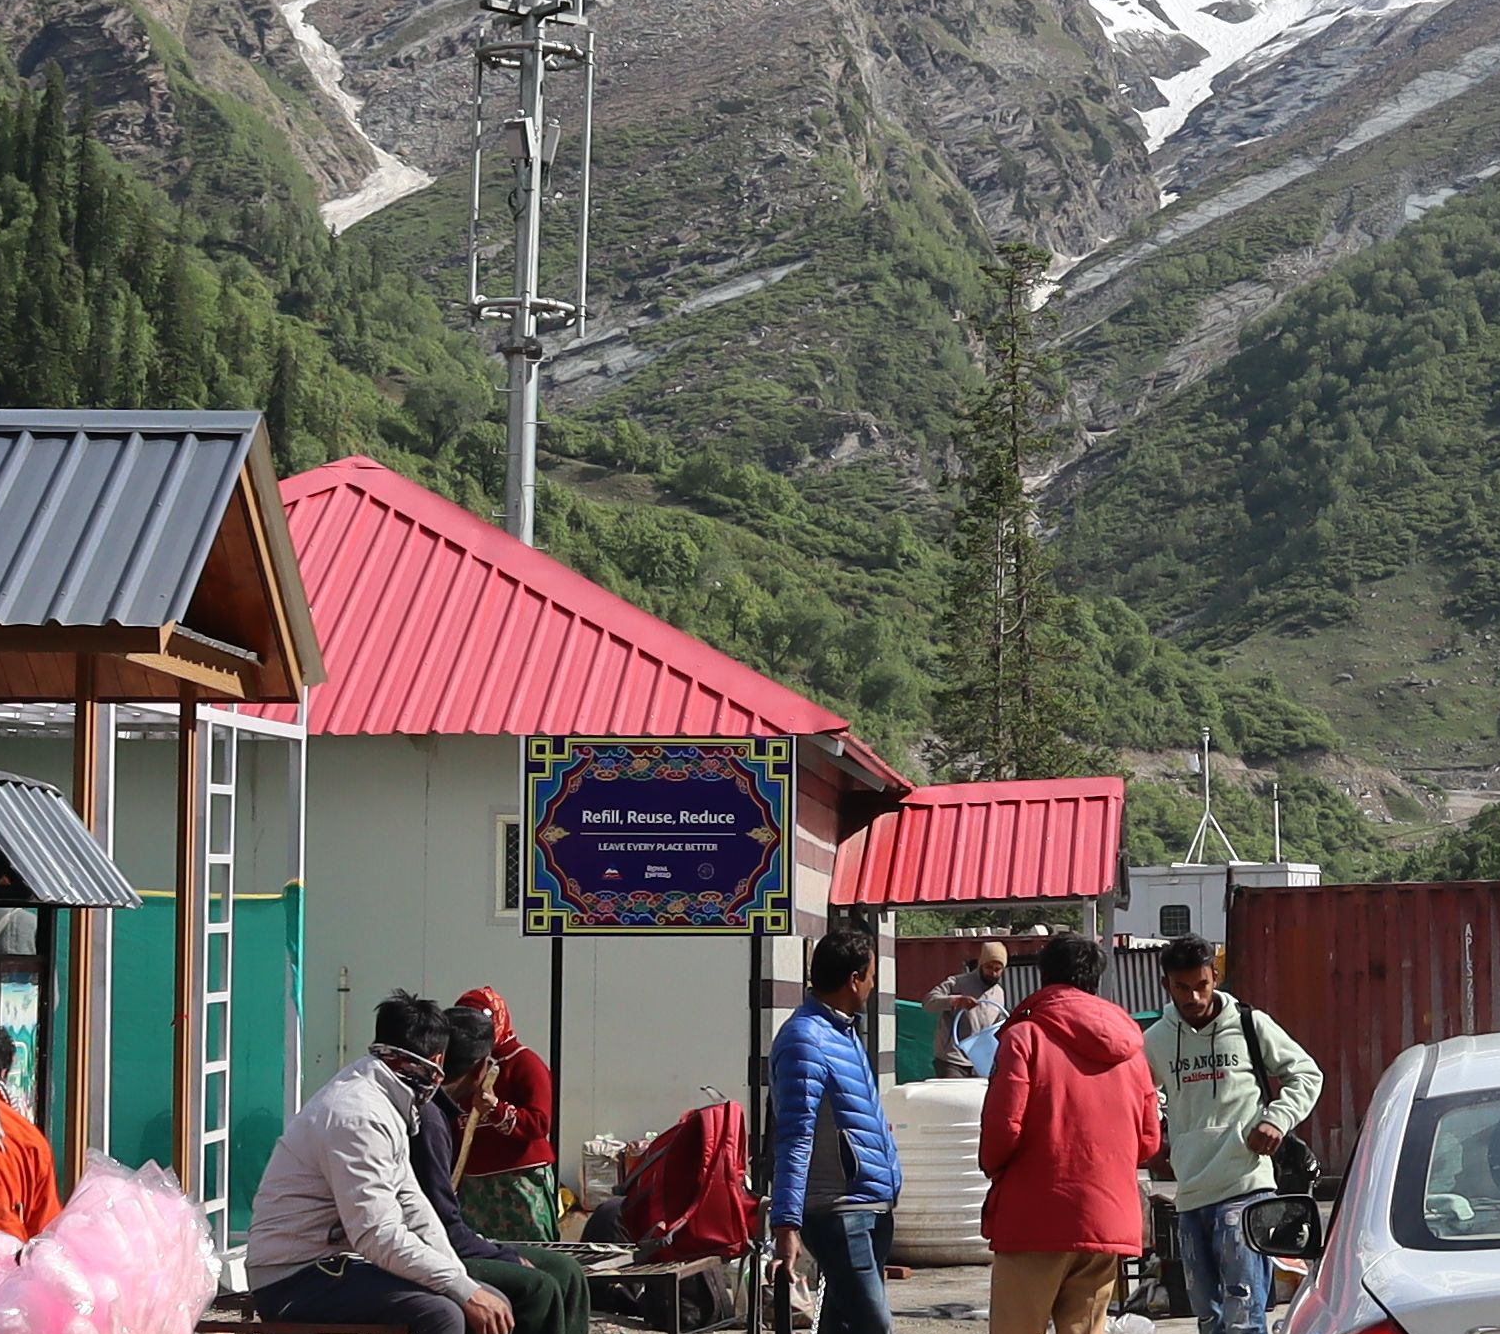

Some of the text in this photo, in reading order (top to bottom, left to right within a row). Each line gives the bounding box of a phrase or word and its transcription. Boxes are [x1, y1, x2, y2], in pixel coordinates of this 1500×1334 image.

[581, 809, 736, 825] Refill, Reuse, Reduce
[598, 842, 719, 852] LEAVE EVERY PLACE BETTER
[1169, 1053, 1239, 1073] LOS ANGELS
